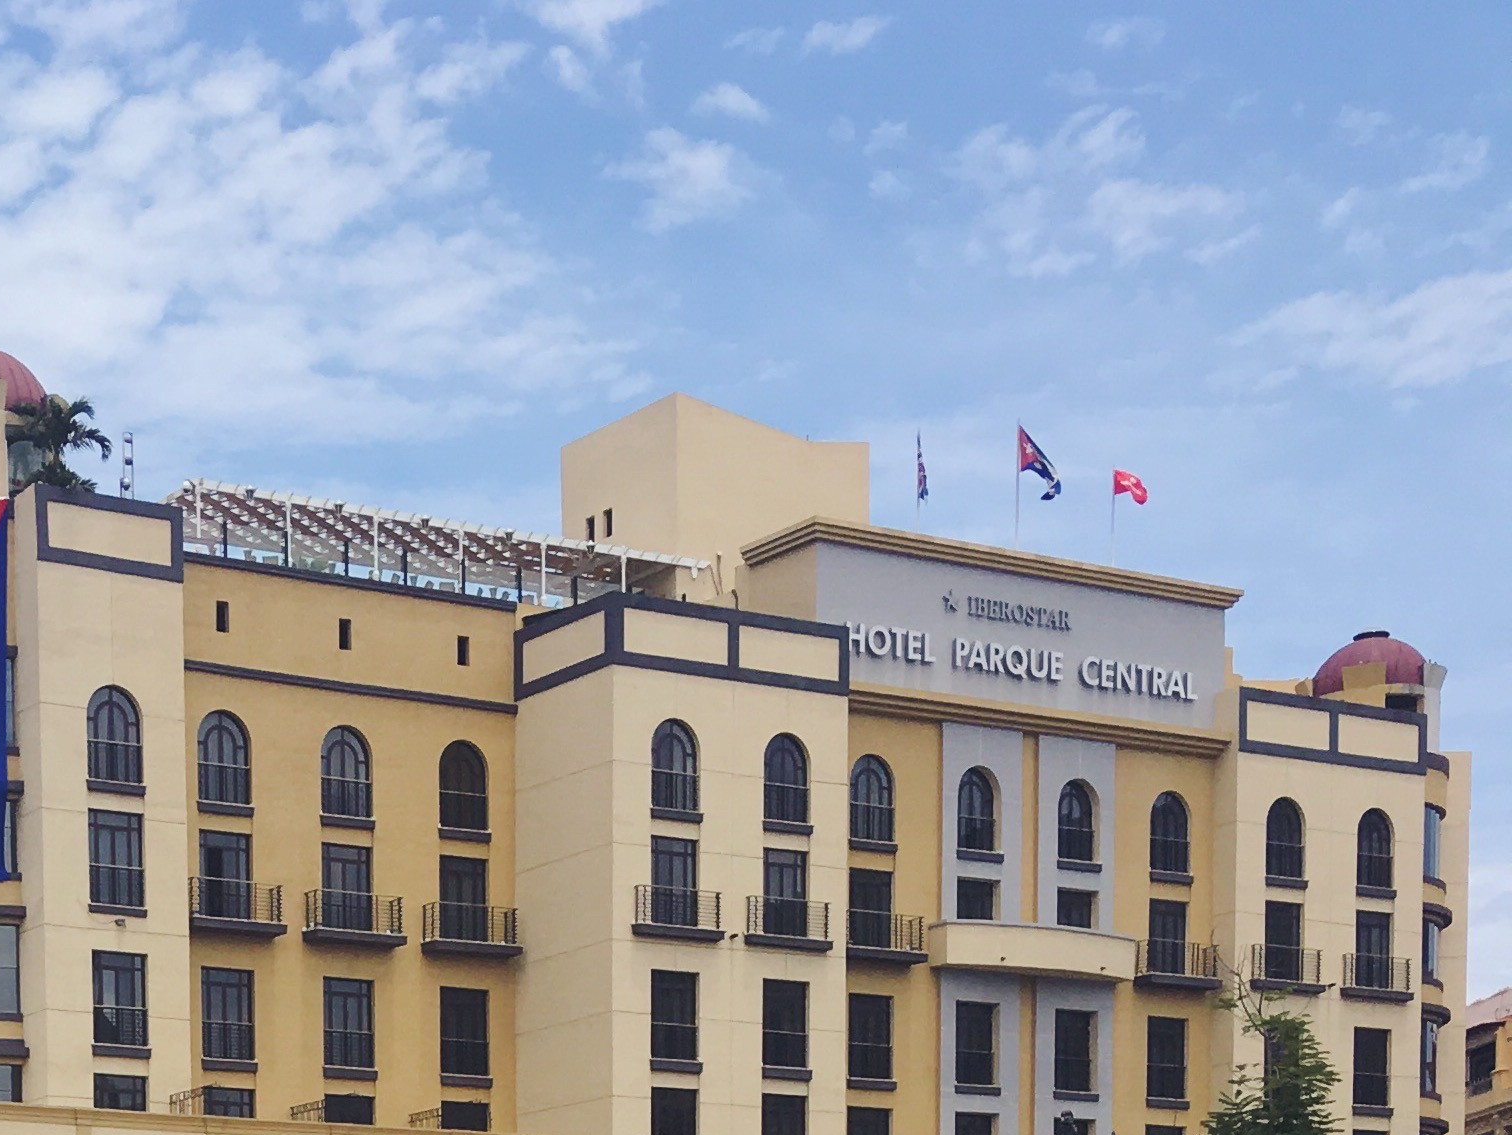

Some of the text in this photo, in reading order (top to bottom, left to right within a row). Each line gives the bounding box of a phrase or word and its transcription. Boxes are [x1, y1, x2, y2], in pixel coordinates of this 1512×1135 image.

[967, 595, 1072, 632] IBEROSTAR
[846, 620, 1199, 701] HOTEL PARQUE CENTRAL
